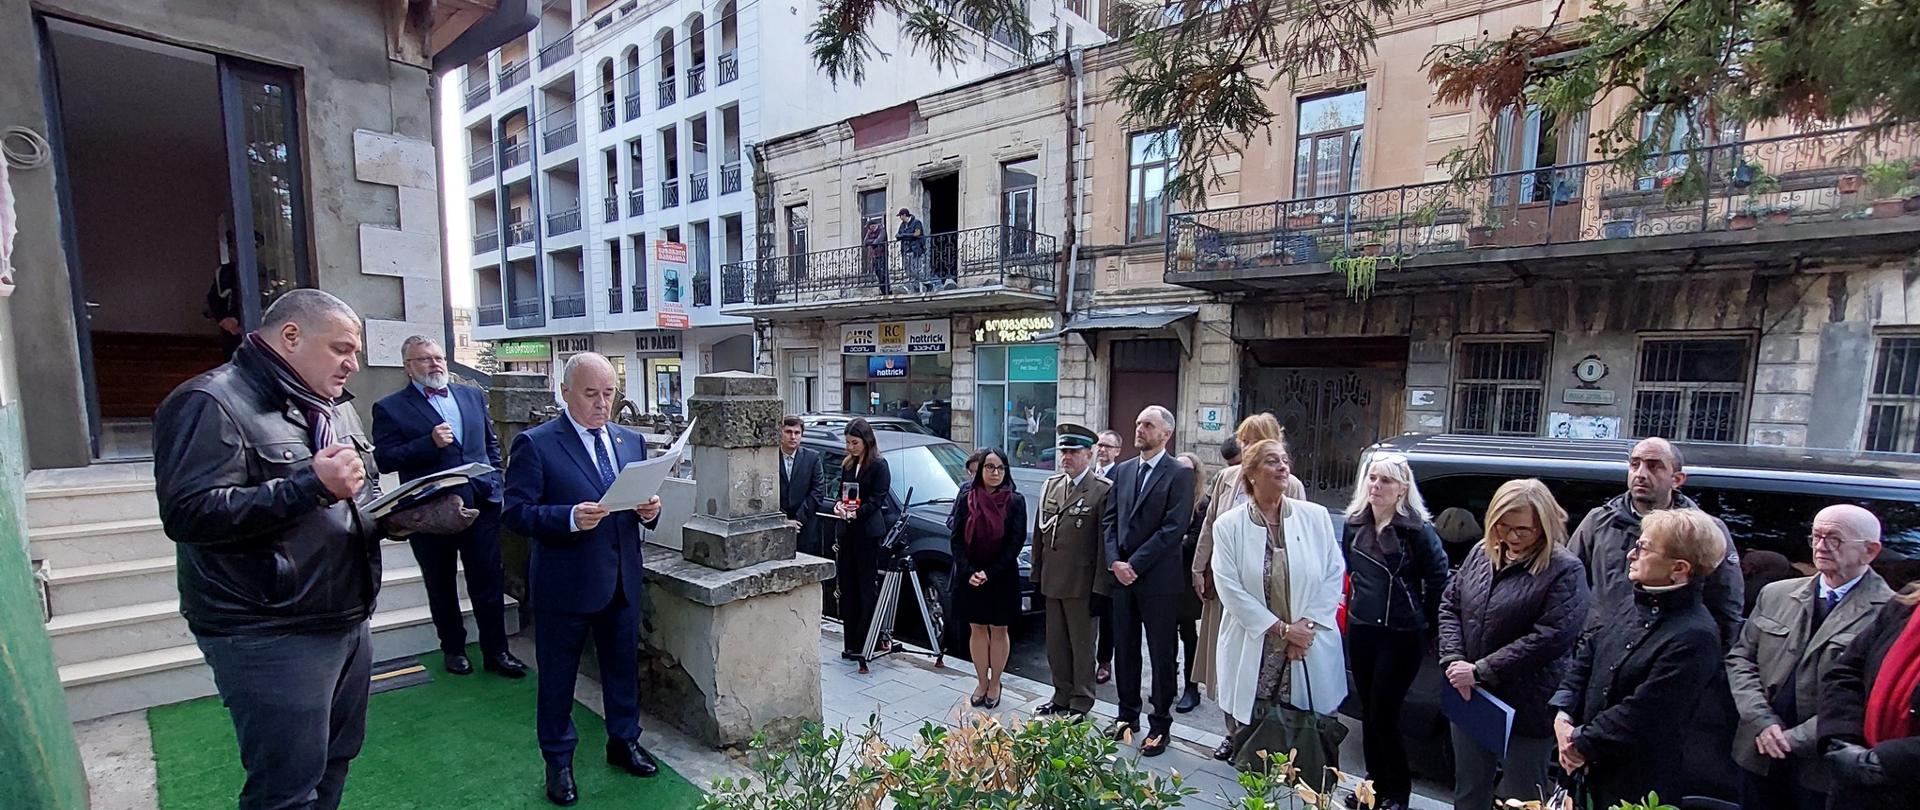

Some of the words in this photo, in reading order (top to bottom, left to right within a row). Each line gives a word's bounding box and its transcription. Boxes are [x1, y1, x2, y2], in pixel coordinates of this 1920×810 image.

[885, 325, 900, 337] RC
[998, 330, 1016, 342] Pet
[636, 336, 648, 350] ICI
[651, 335, 676, 350] PARIS
[1587, 364, 1594, 376] 8
[1208, 410, 1216, 421] 8
